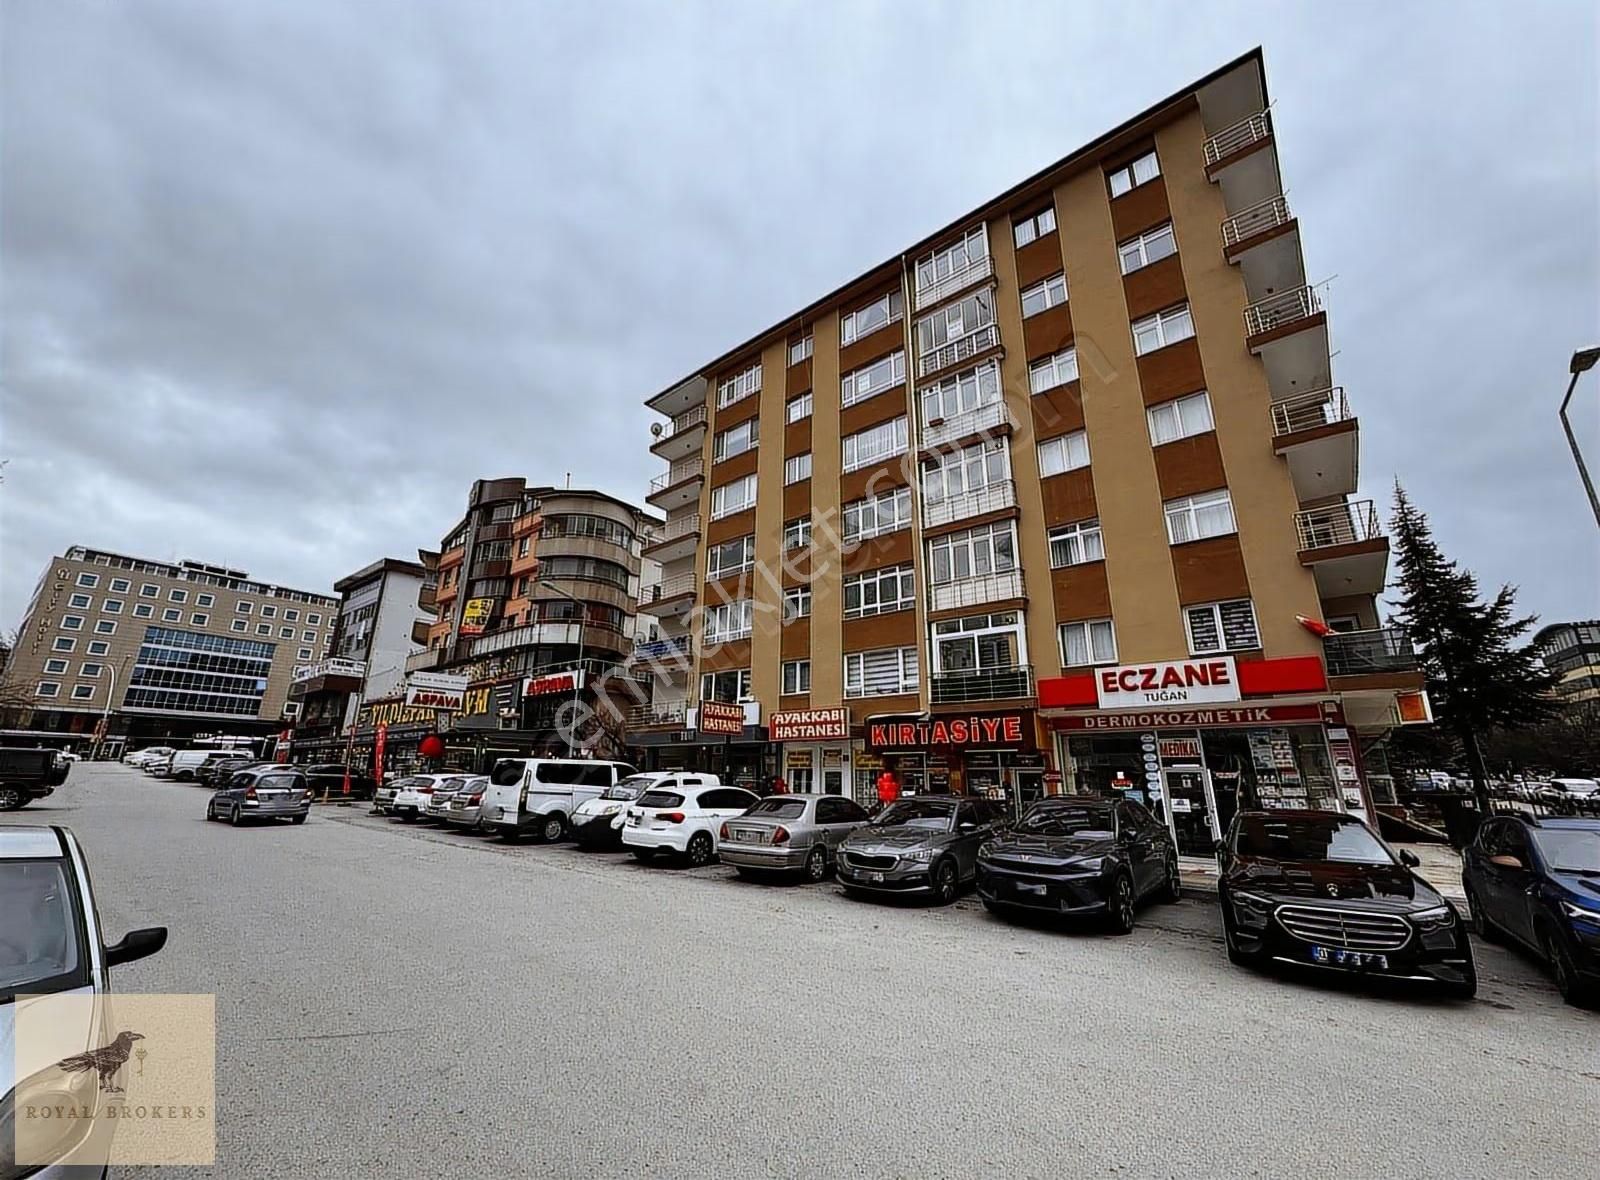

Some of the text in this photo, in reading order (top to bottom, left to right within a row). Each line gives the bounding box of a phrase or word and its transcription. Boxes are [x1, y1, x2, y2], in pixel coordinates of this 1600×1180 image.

[1102, 661, 1230, 694] ECZANE
[1144, 689, 1188, 703] TUĞAN
[773, 709, 844, 725] AYAKKABI
[1083, 707, 1271, 729] DERMOKOZMETİK
[871, 716, 1023, 746] KIRTASİYE
